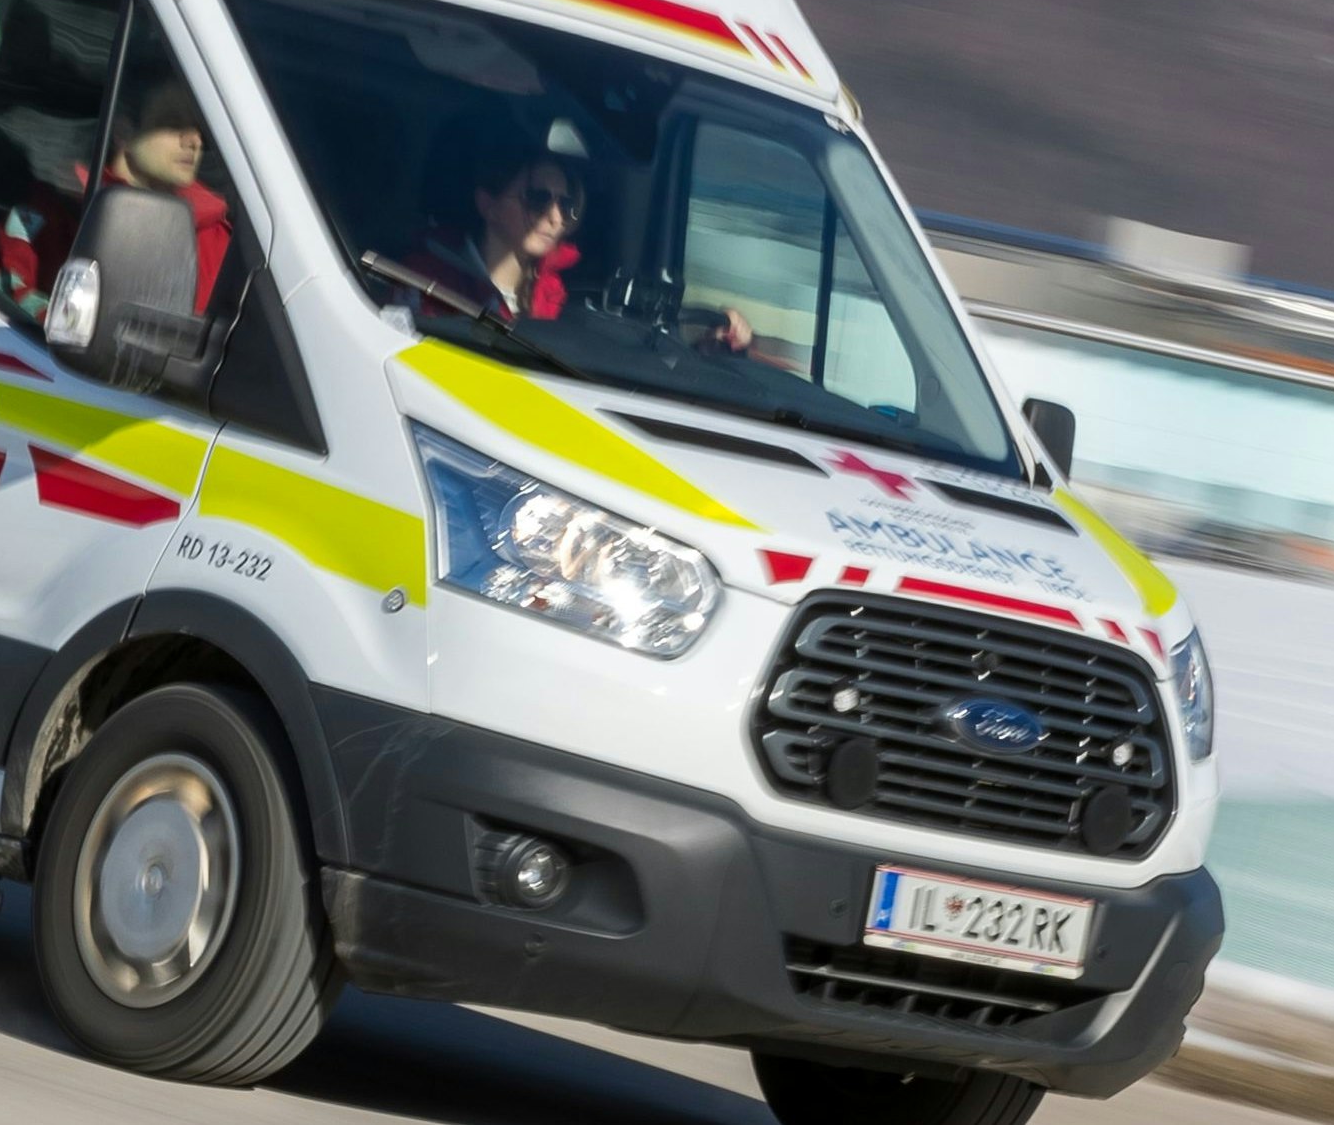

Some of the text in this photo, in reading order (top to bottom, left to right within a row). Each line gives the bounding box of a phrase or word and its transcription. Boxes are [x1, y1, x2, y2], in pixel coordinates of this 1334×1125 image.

[176, 533, 274, 582] RD 13-232
[825, 508, 1075, 584] AMBULANCE
